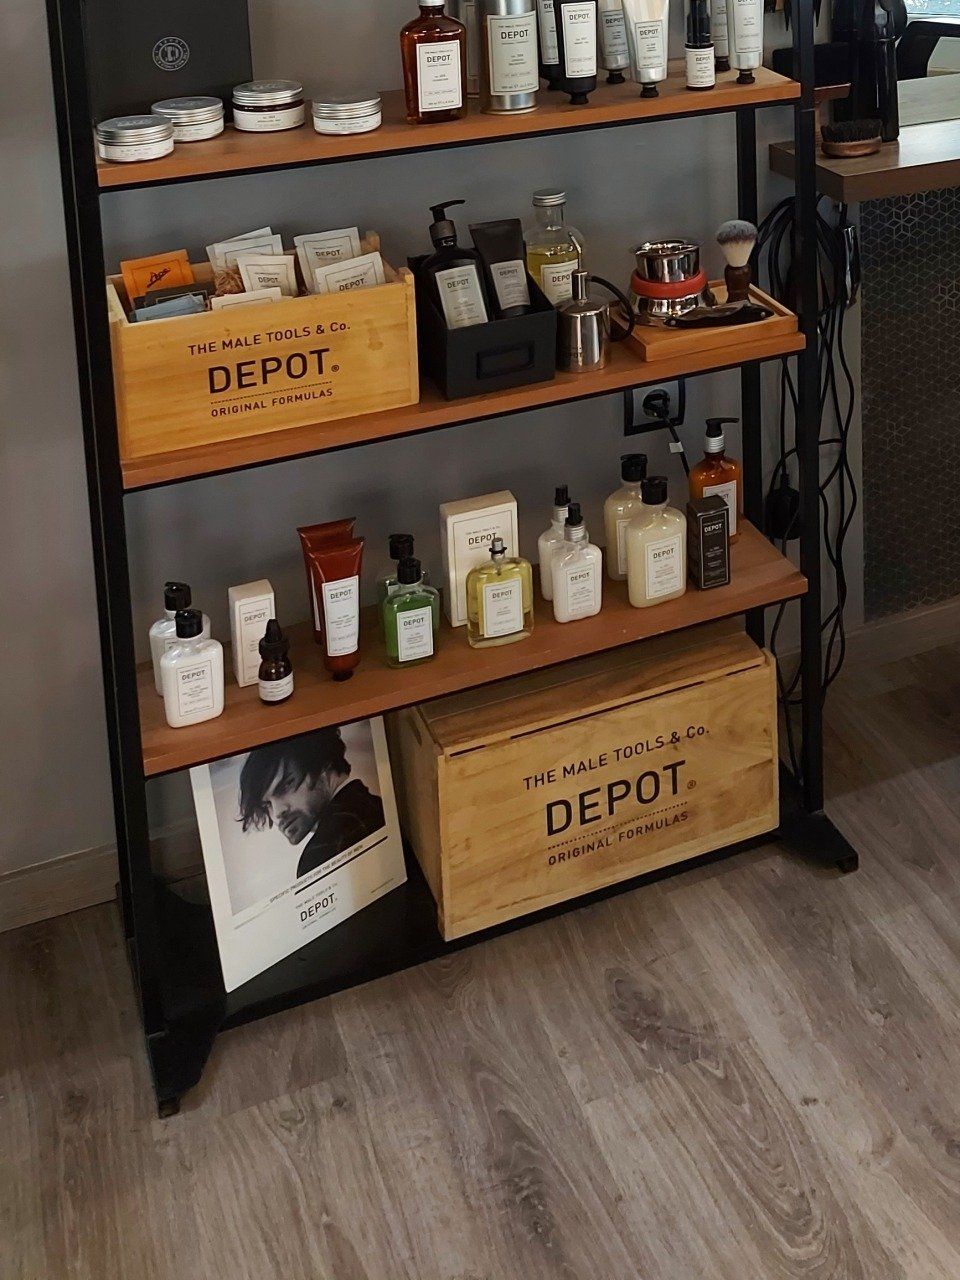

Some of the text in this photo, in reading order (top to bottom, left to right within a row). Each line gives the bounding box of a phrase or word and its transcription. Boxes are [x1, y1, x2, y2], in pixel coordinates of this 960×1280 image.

[568, 13, 590, 21] DEPOT
[500, 29, 529, 40] DEPOT
[640, 28, 659, 36] DEPOT
[426, 54, 451, 63] DEPOT
[315, 249, 340, 258] DEPOT
[447, 278, 469, 289] DEPOT
[552, 274, 571, 283] DEPO
[339, 277, 367, 292] DEPOT
[188, 322, 351, 356] THE MALE TOOLS & Co.
[211, 388, 333, 417] ORIGINAL FORMULAS
[653, 547, 675, 559] DEPOT
[570, 571, 590, 582] DEPOT
[330, 589, 352, 600] DEPOT
[492, 589, 513, 599] DEPOT
[403, 617, 425, 627] DEPOT
[523, 724, 710, 790] THE MALE TOOLS & Co.
[548, 811, 688, 866] ORIGINAL FORMULAS
[300, 893, 337, 922] DEPOT
